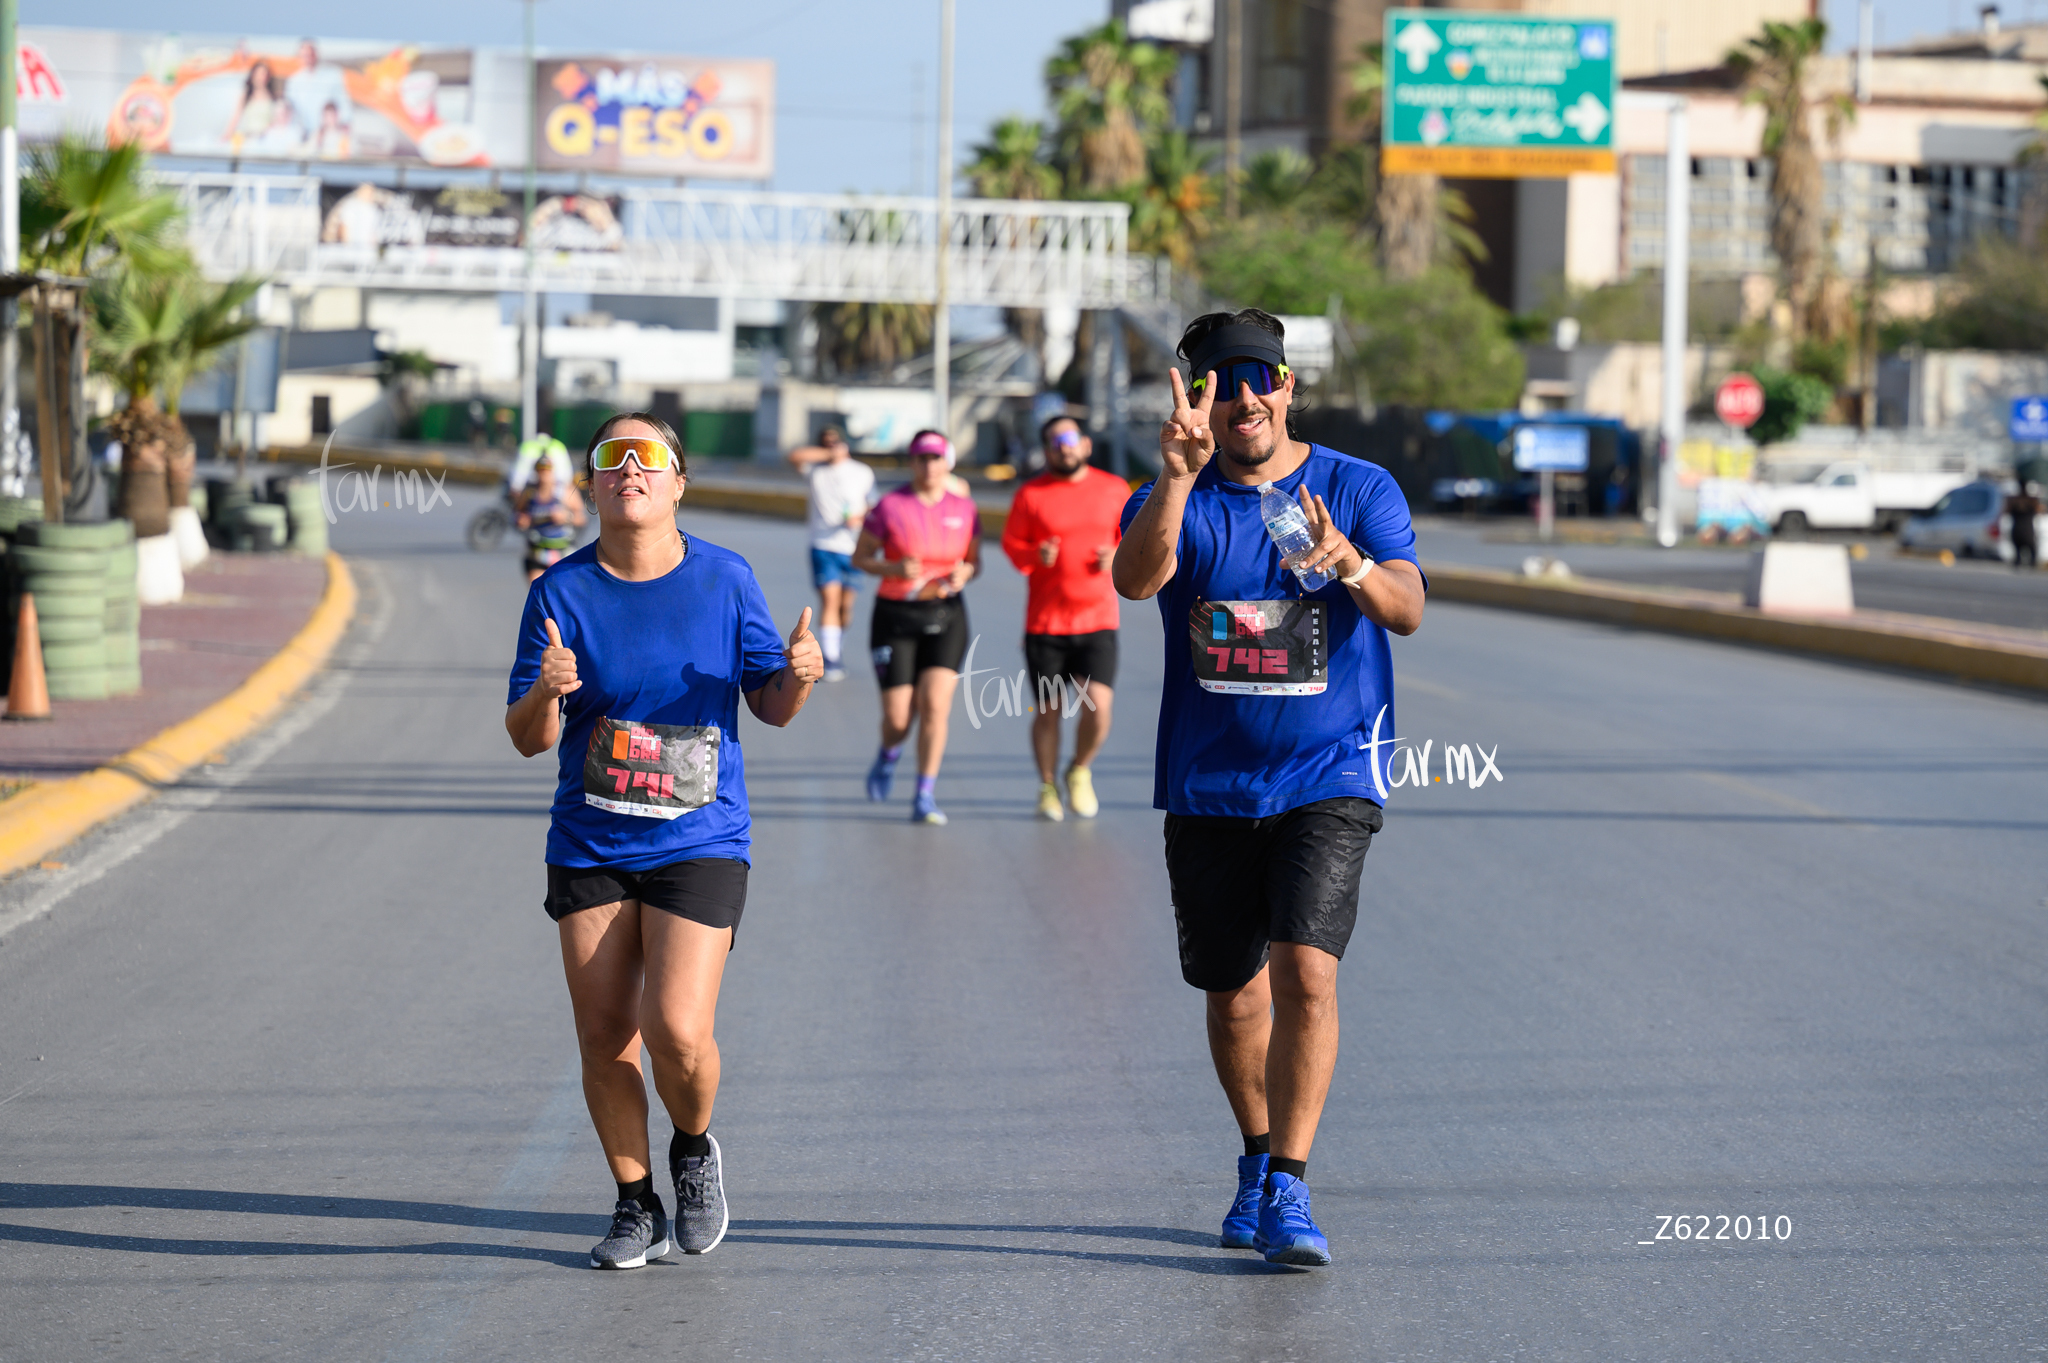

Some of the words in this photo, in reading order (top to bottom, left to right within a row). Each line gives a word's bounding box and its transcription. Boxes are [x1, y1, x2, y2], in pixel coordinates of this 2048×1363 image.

[597, 63, 689, 108] MÁS
[546, 104, 733, 160] Q-ESO
[1207, 647, 1288, 674] 742
[1311, 608, 1320, 676] MEDALLA
[607, 767, 674, 798] 741
[703, 734, 715, 802] MEDALLA
